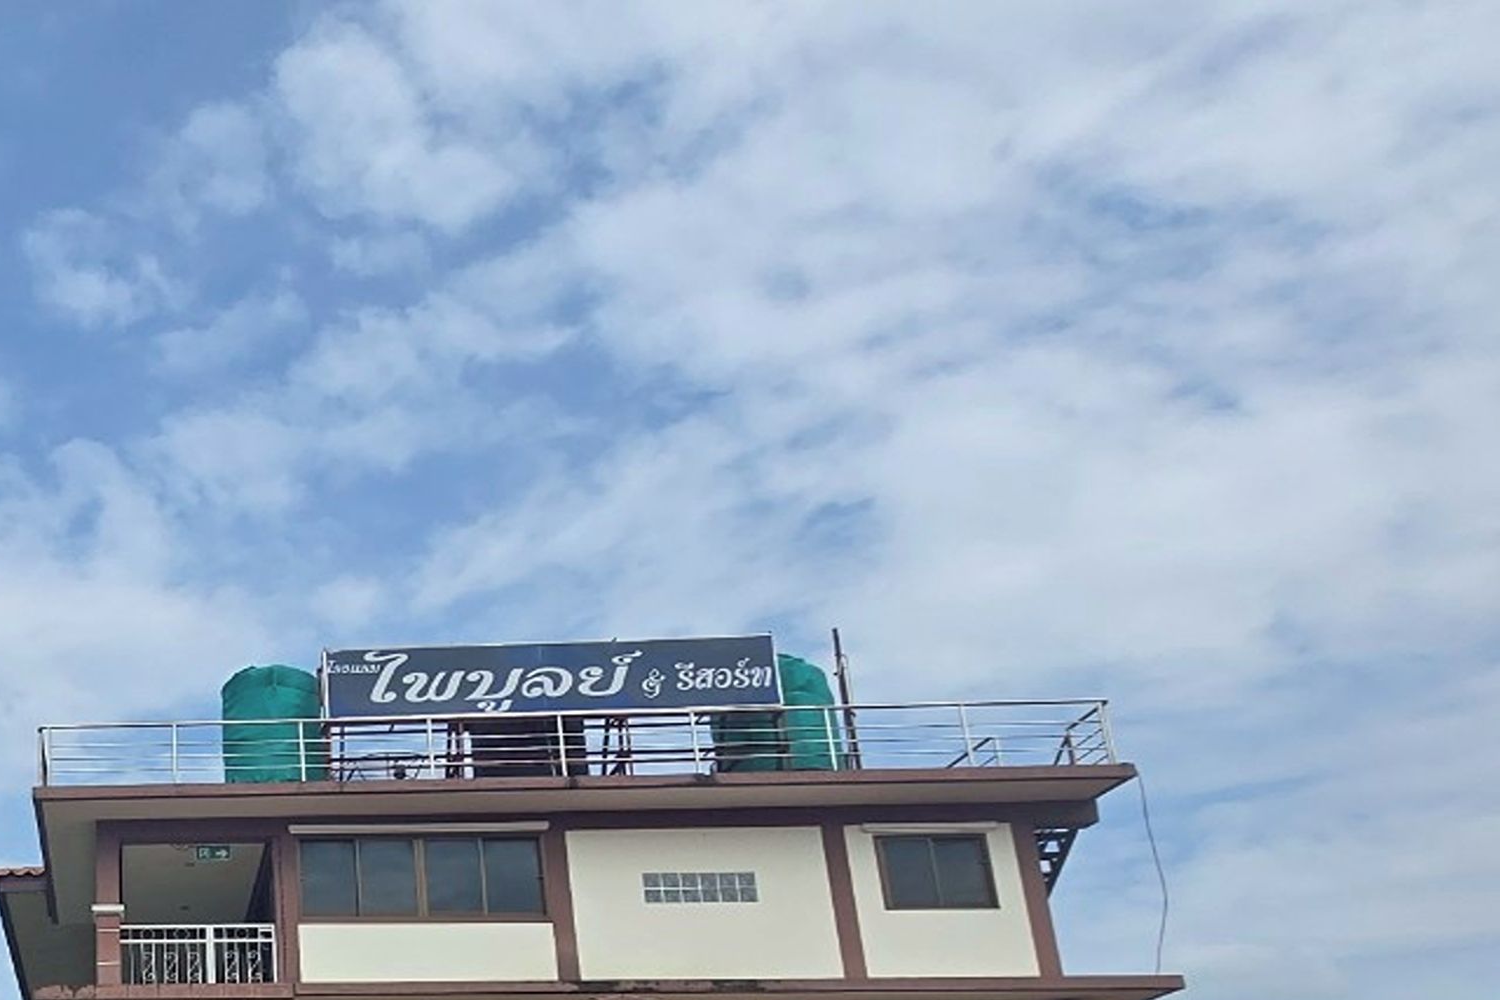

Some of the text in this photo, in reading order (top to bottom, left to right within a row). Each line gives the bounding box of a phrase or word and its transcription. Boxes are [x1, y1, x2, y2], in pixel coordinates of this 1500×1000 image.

[363, 651, 642, 712] ไพบูลย์
[642, 668, 666, 698] &
[674, 658, 772, 690] รีสอร์ท
